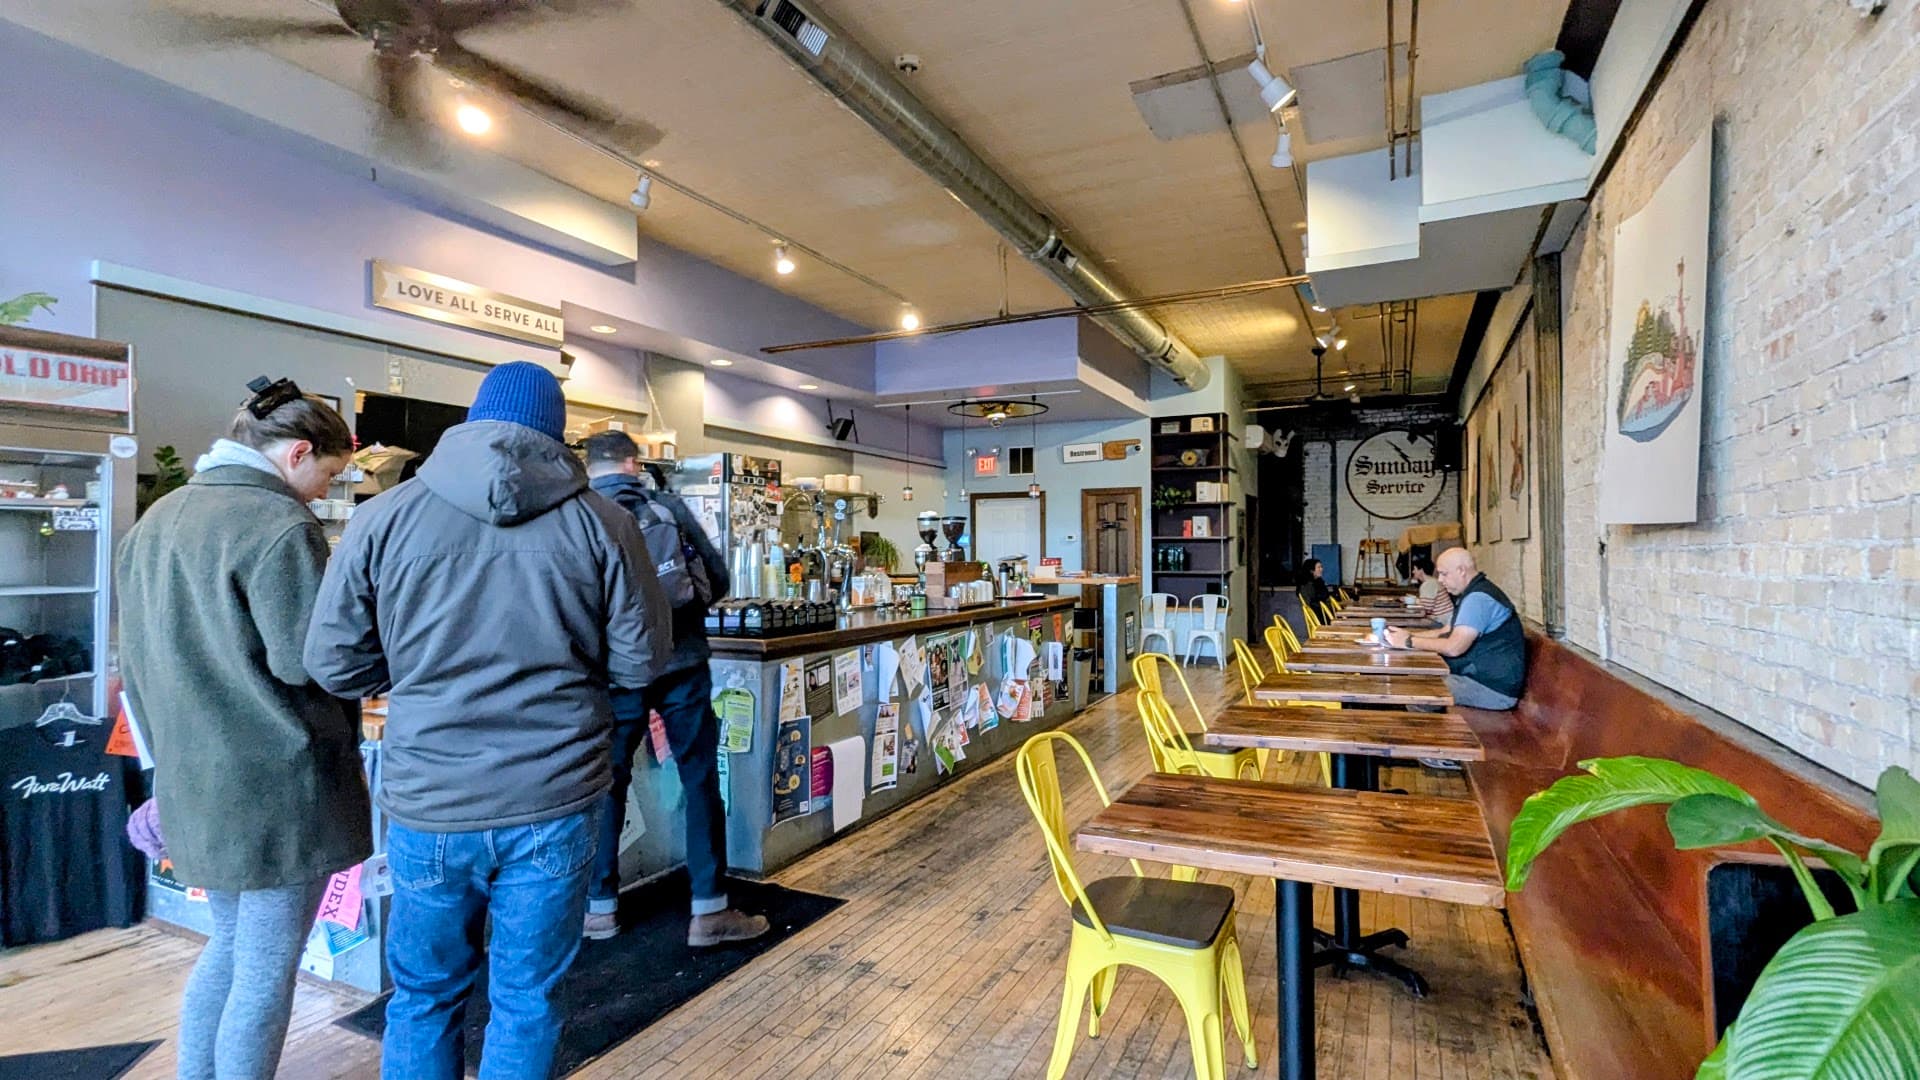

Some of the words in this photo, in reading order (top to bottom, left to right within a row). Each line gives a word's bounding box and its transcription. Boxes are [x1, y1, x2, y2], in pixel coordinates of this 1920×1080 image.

[398, 281, 443, 304] LOVE
[450, 296, 478, 313] ALL
[484, 304, 529, 326] SERVE
[535, 318, 558, 333] ALL
[978, 457, 995, 471] EXIT
[1354, 450, 1437, 478] Sunday
[1366, 480, 1425, 495] Service
[321, 871, 350, 918] DEX
